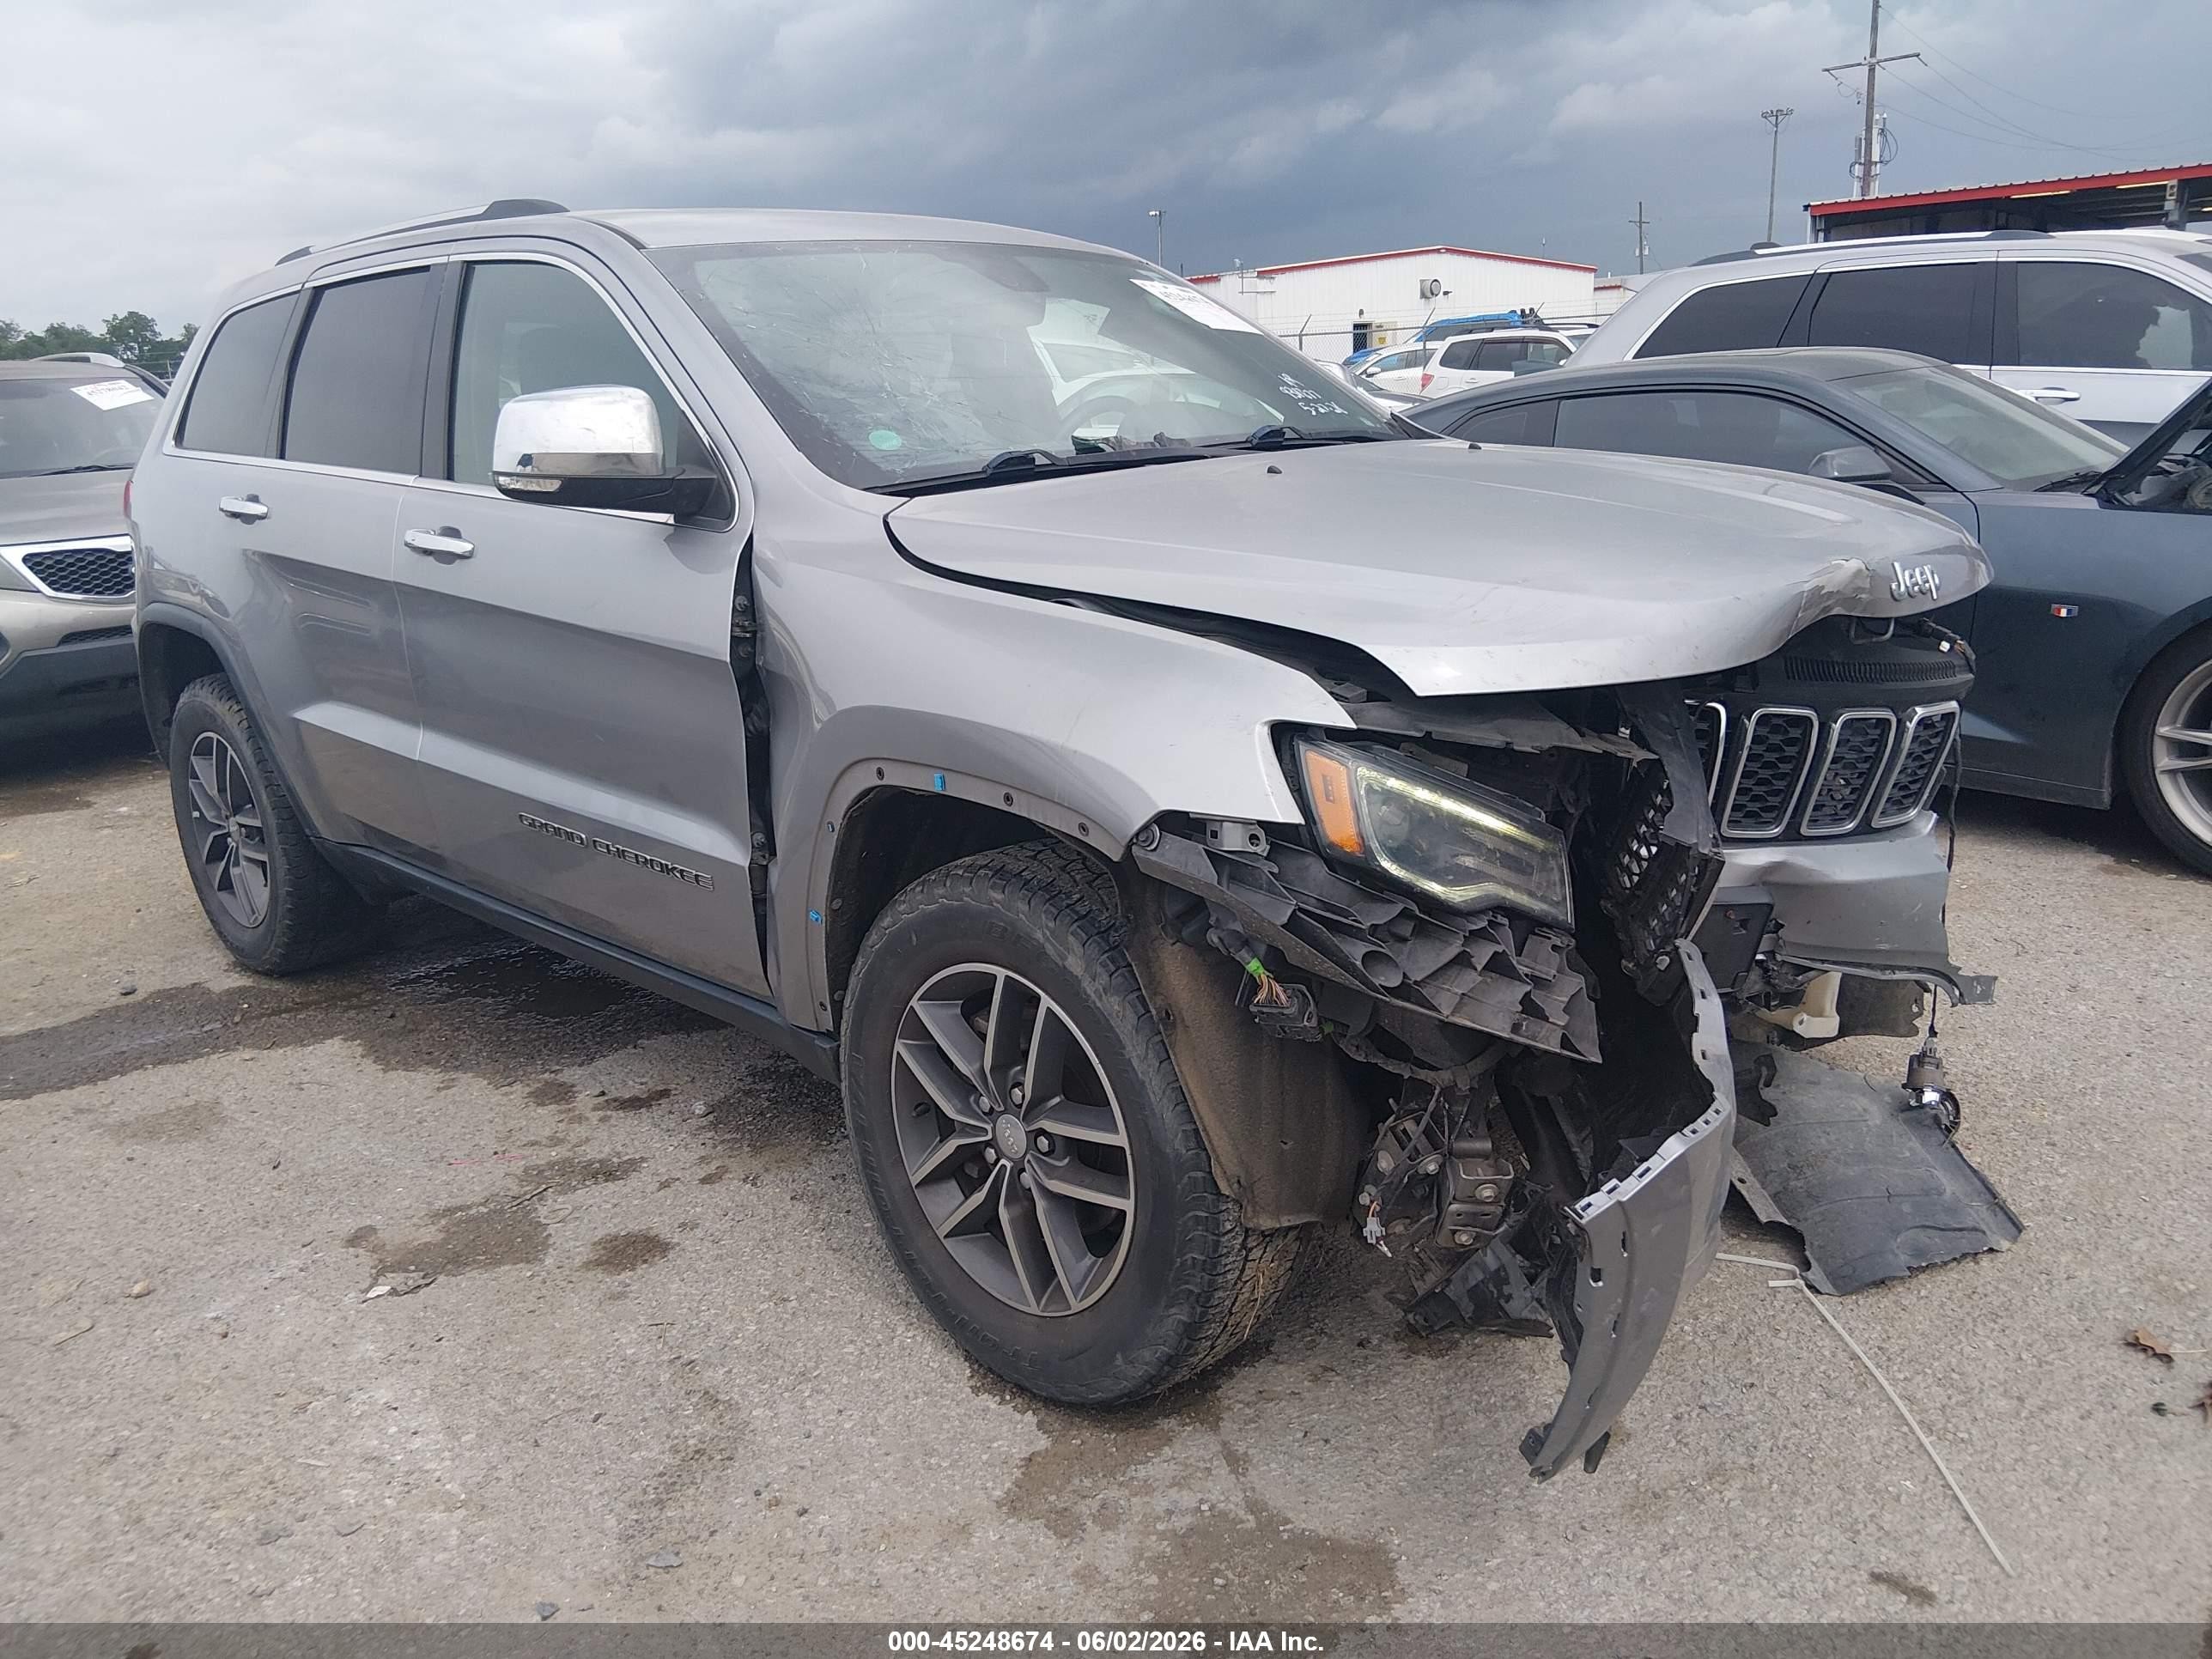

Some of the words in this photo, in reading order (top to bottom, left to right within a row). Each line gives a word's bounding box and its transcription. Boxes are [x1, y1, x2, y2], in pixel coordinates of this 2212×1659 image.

[1889, 561, 1941, 601] Jeep
[518, 811, 589, 848] GRAND
[592, 836, 715, 892] CHEROKEE
